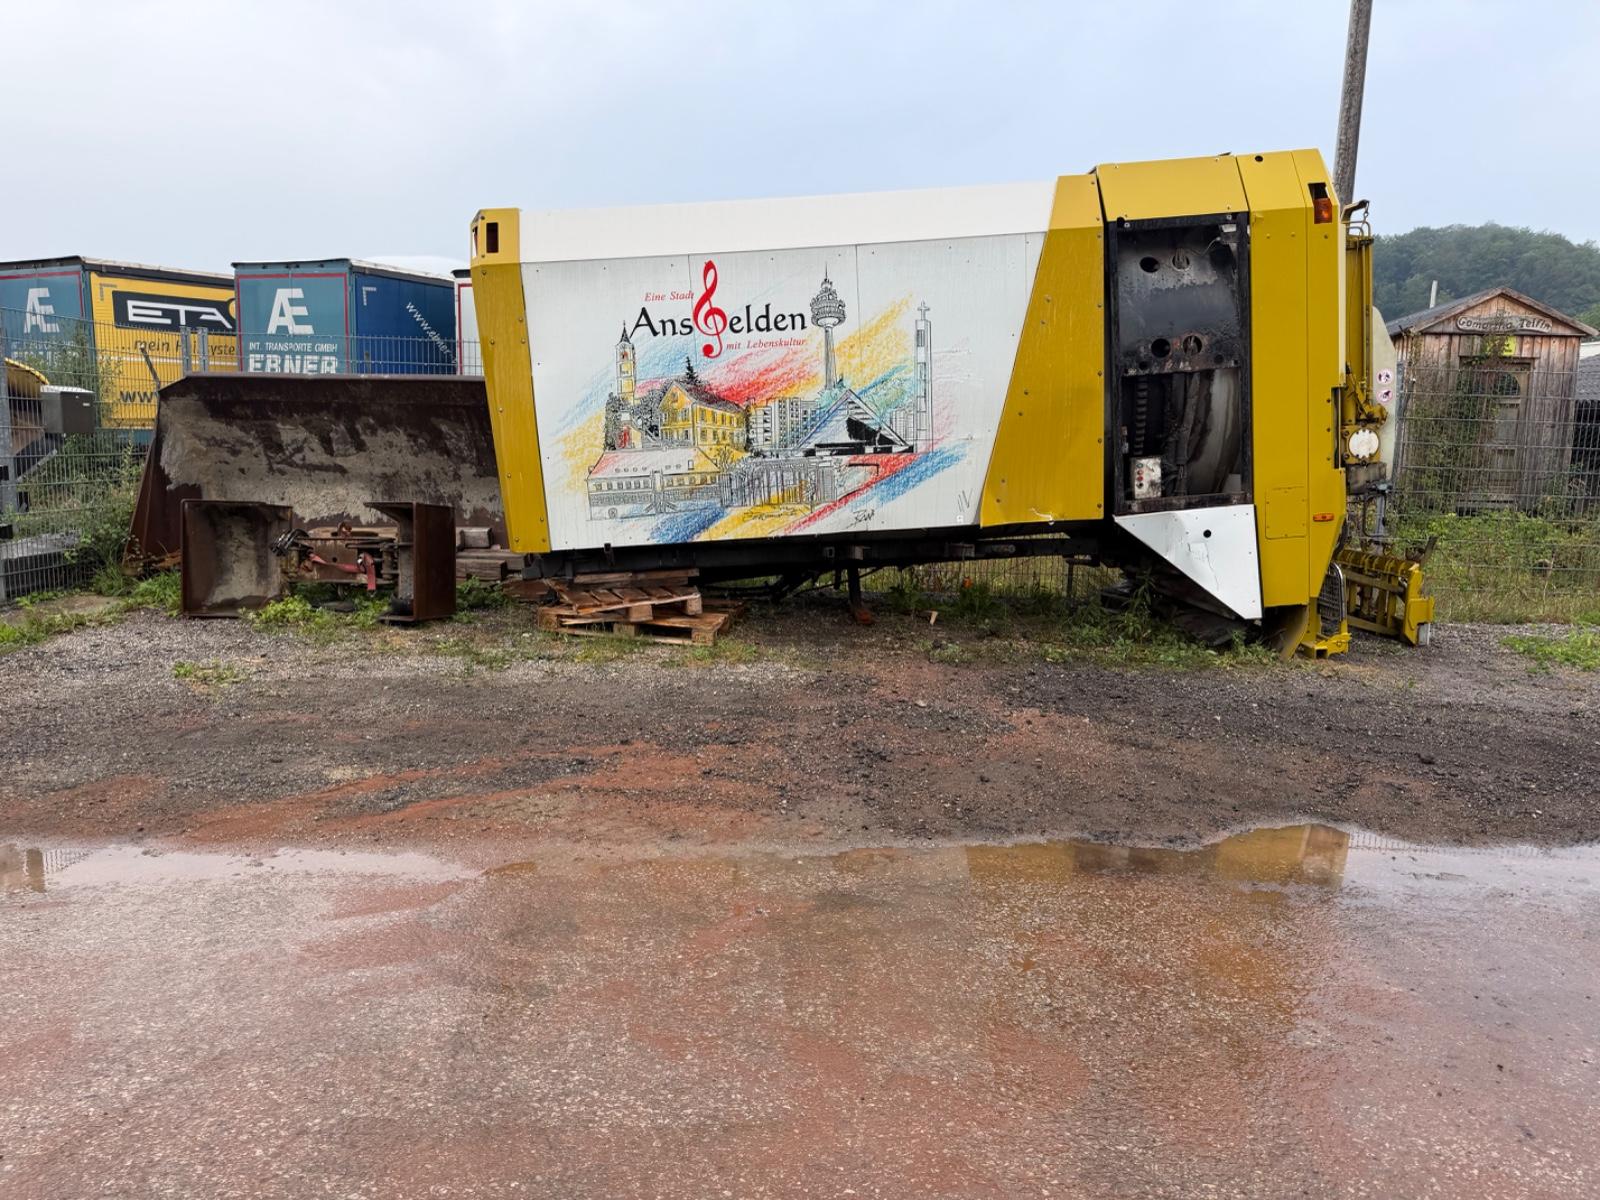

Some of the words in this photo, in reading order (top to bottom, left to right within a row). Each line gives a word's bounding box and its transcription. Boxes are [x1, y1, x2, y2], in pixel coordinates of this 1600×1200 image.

[644, 292, 665, 302] Eine
[669, 291, 695, 300] Stadt
[126, 300, 233, 329] ETA
[265, 342, 313, 352] TRANSPORTE
[314, 343, 338, 353] GMBH
[726, 342, 742, 350] mit
[746, 338, 806, 350] Lebenskultur
[248, 353, 338, 374] EBNER
